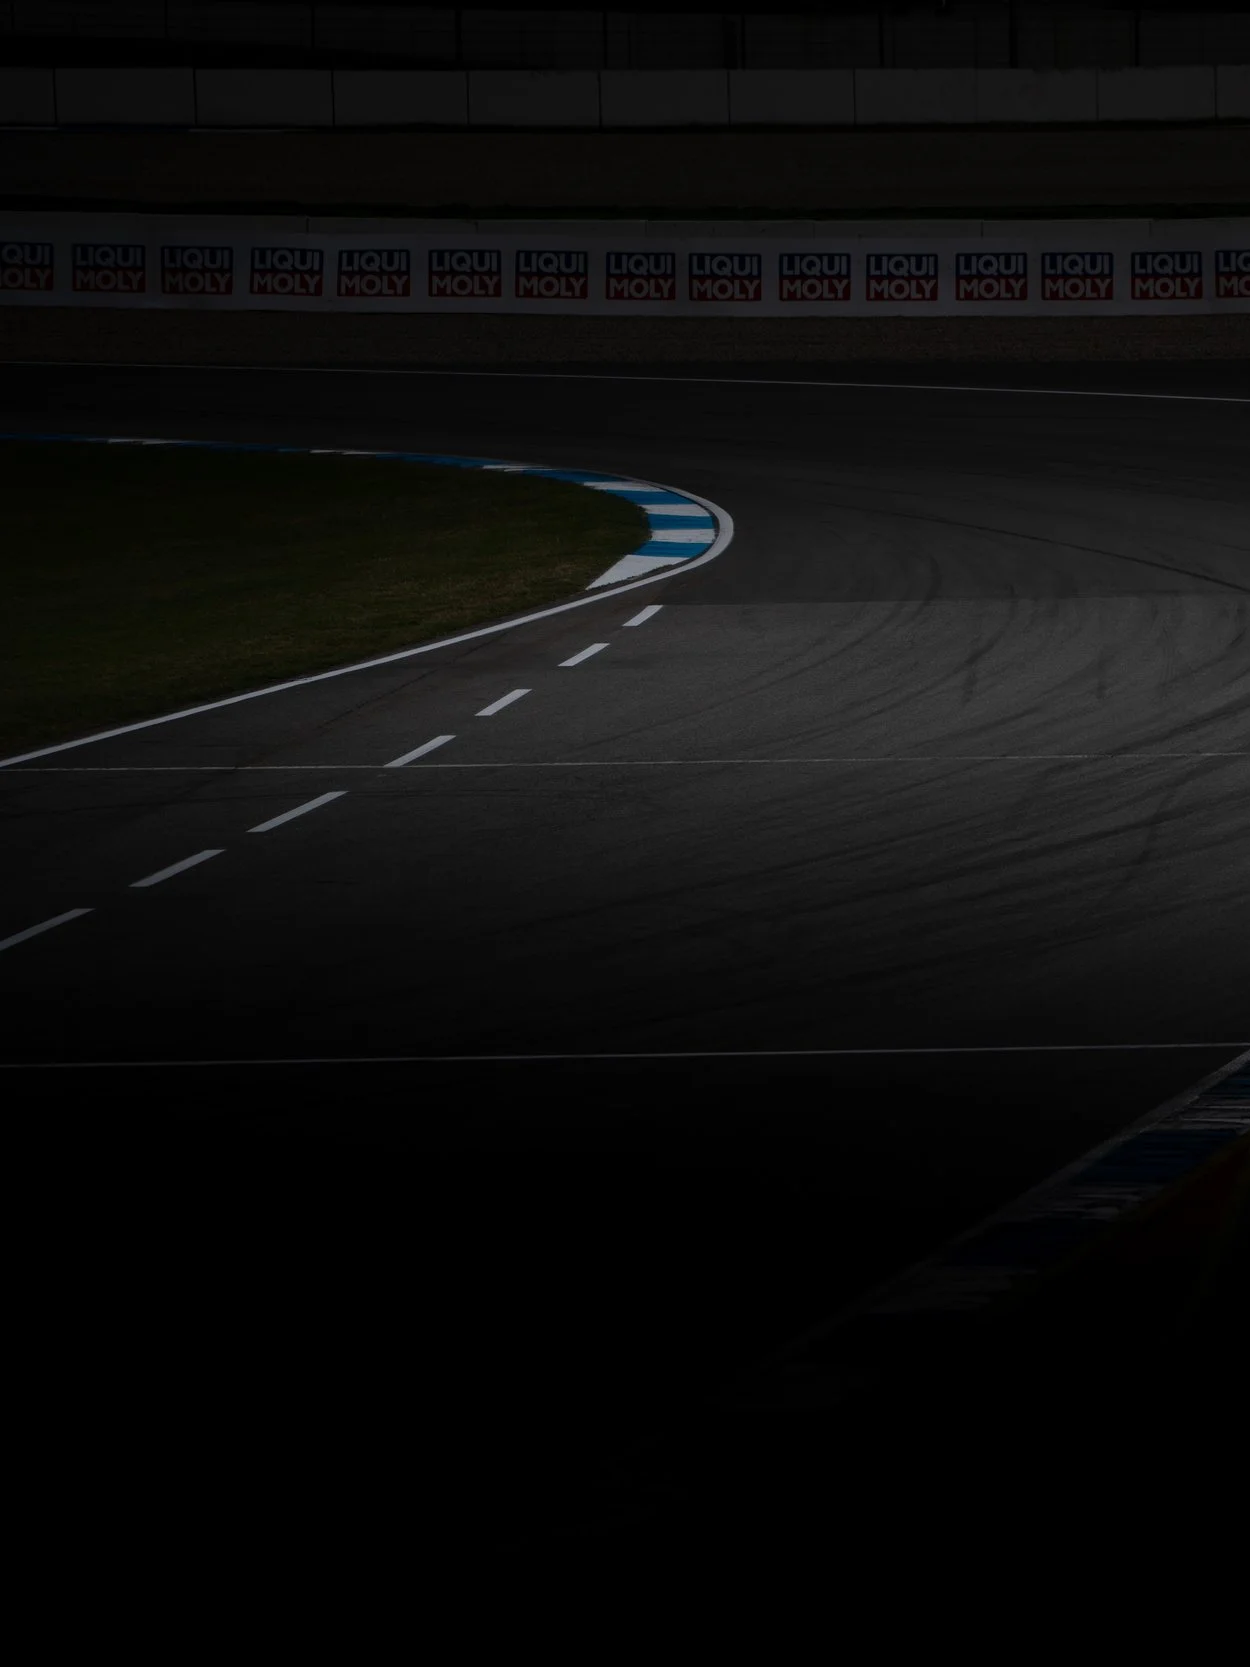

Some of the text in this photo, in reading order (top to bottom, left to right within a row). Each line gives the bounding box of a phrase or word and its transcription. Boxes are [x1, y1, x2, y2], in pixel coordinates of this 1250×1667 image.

[2, 244, 51, 266] QUI
[75, 246, 143, 269] LIQUI
[164, 248, 231, 271] LIQUI
[253, 249, 322, 272] LIQUI
[340, 251, 408, 274] LIQUI
[431, 251, 500, 274] LIQUI
[518, 252, 586, 276] LIQUI
[609, 254, 674, 277] LIQUI
[692, 255, 760, 278] LIQUI
[781, 255, 849, 278] LIQUI
[869, 255, 936, 278] LIQUI
[958, 255, 1026, 278] LIQUI
[1044, 254, 1112, 277] LIQUI
[1132, 253, 1201, 276] LIQUI
[0, 266, 52, 288] OLY
[75, 269, 144, 291] MOLY
[164, 271, 232, 293] MOLY
[253, 272, 323, 295] MOLY
[340, 274, 409, 297] MOLY
[431, 274, 501, 297] MOLY
[518, 276, 587, 299] MOLY
[609, 277, 675, 300] MOLY
[1044, 277, 1113, 300] MOLY
[1132, 276, 1202, 299] MOLY
[692, 278, 761, 301] MOLY
[781, 278, 850, 300] MOLY
[869, 278, 937, 301] MOLY
[958, 278, 1027, 300] MOLY
